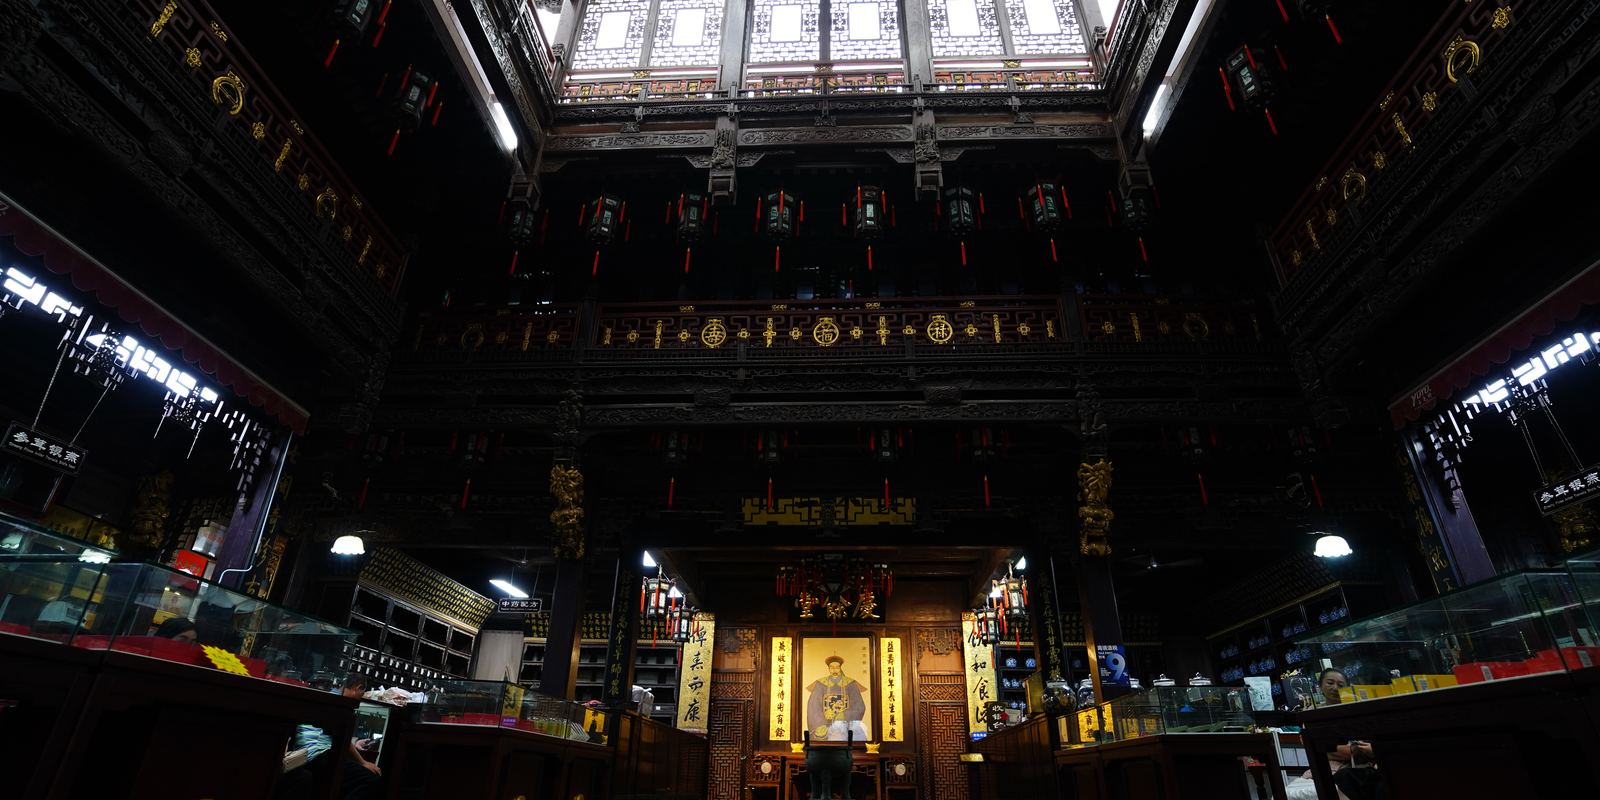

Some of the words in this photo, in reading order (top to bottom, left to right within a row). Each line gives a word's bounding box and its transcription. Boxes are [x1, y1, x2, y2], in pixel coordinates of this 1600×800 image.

[501, 600, 539, 609] 中药配方
[1106, 653, 1126, 681] 9
